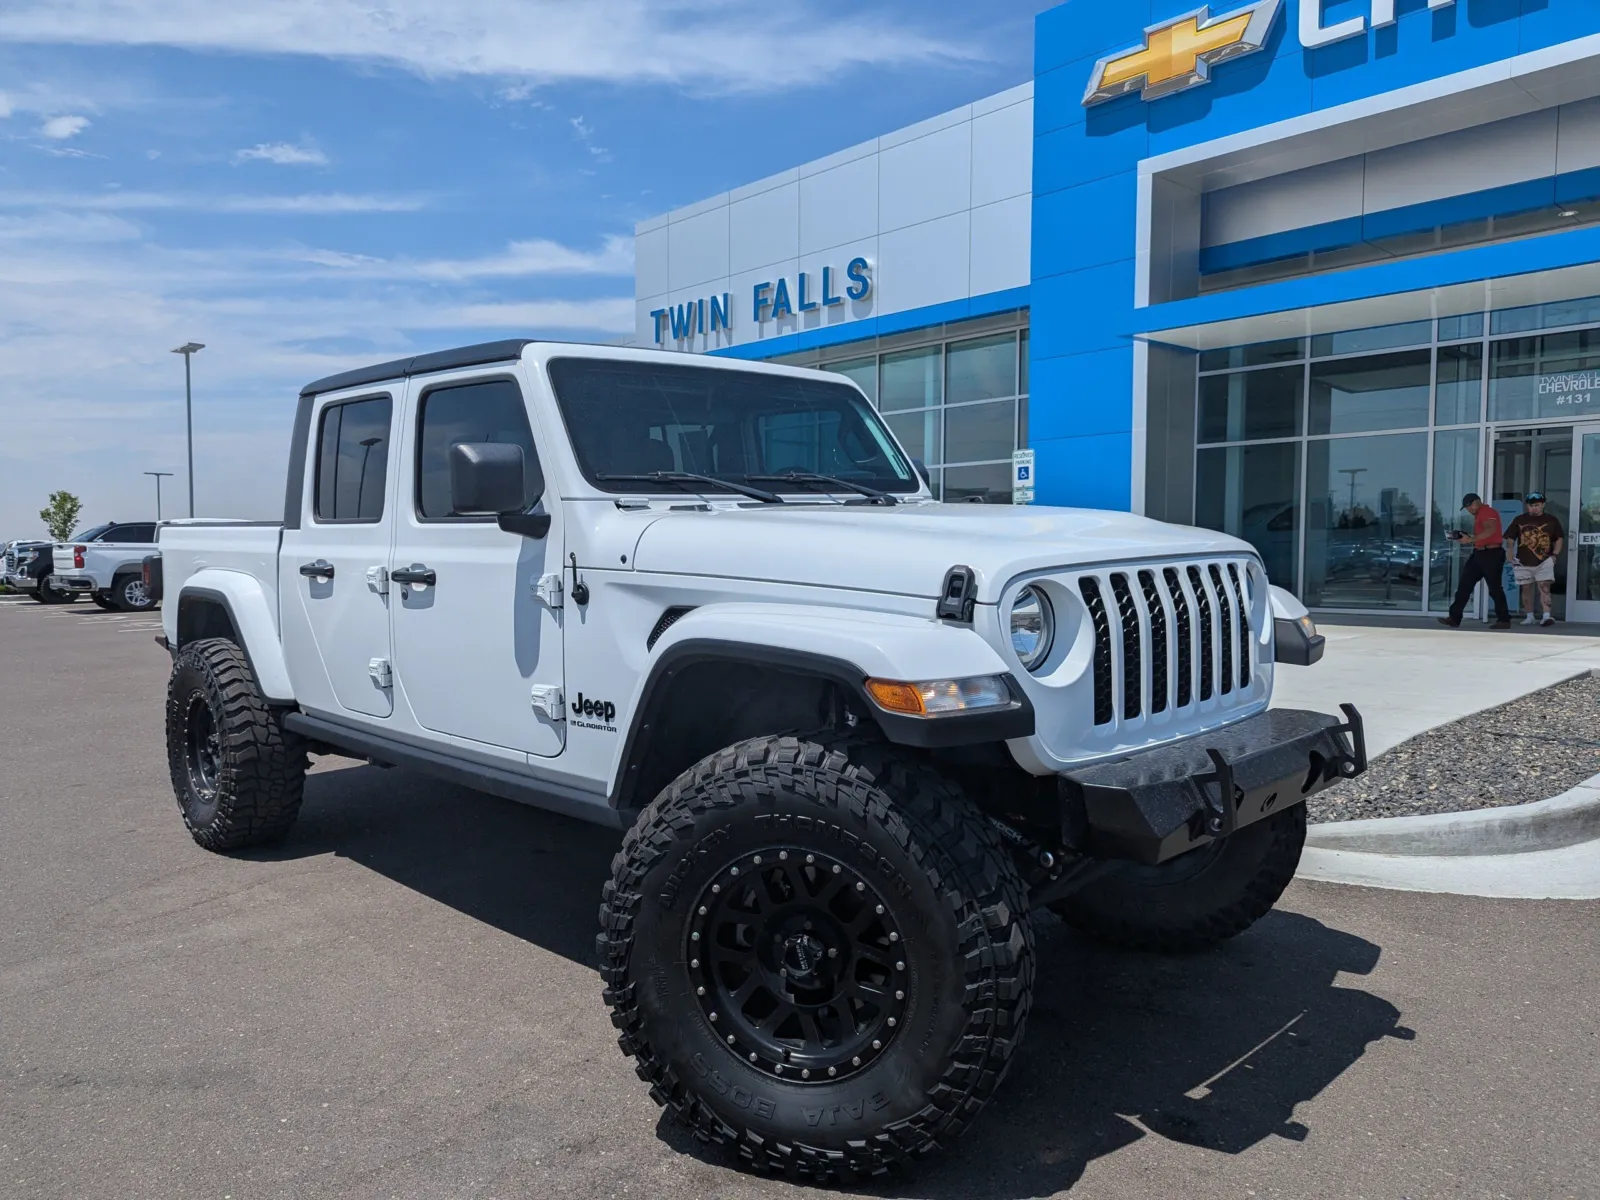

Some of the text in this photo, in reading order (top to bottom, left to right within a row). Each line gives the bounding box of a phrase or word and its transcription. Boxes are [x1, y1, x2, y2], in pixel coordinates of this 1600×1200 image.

[650, 257, 874, 344] TWIN FALLS
[1556, 392, 1591, 405] #131
[571, 692, 616, 722] Jeep
[577, 720, 617, 733] GLADIATOR
